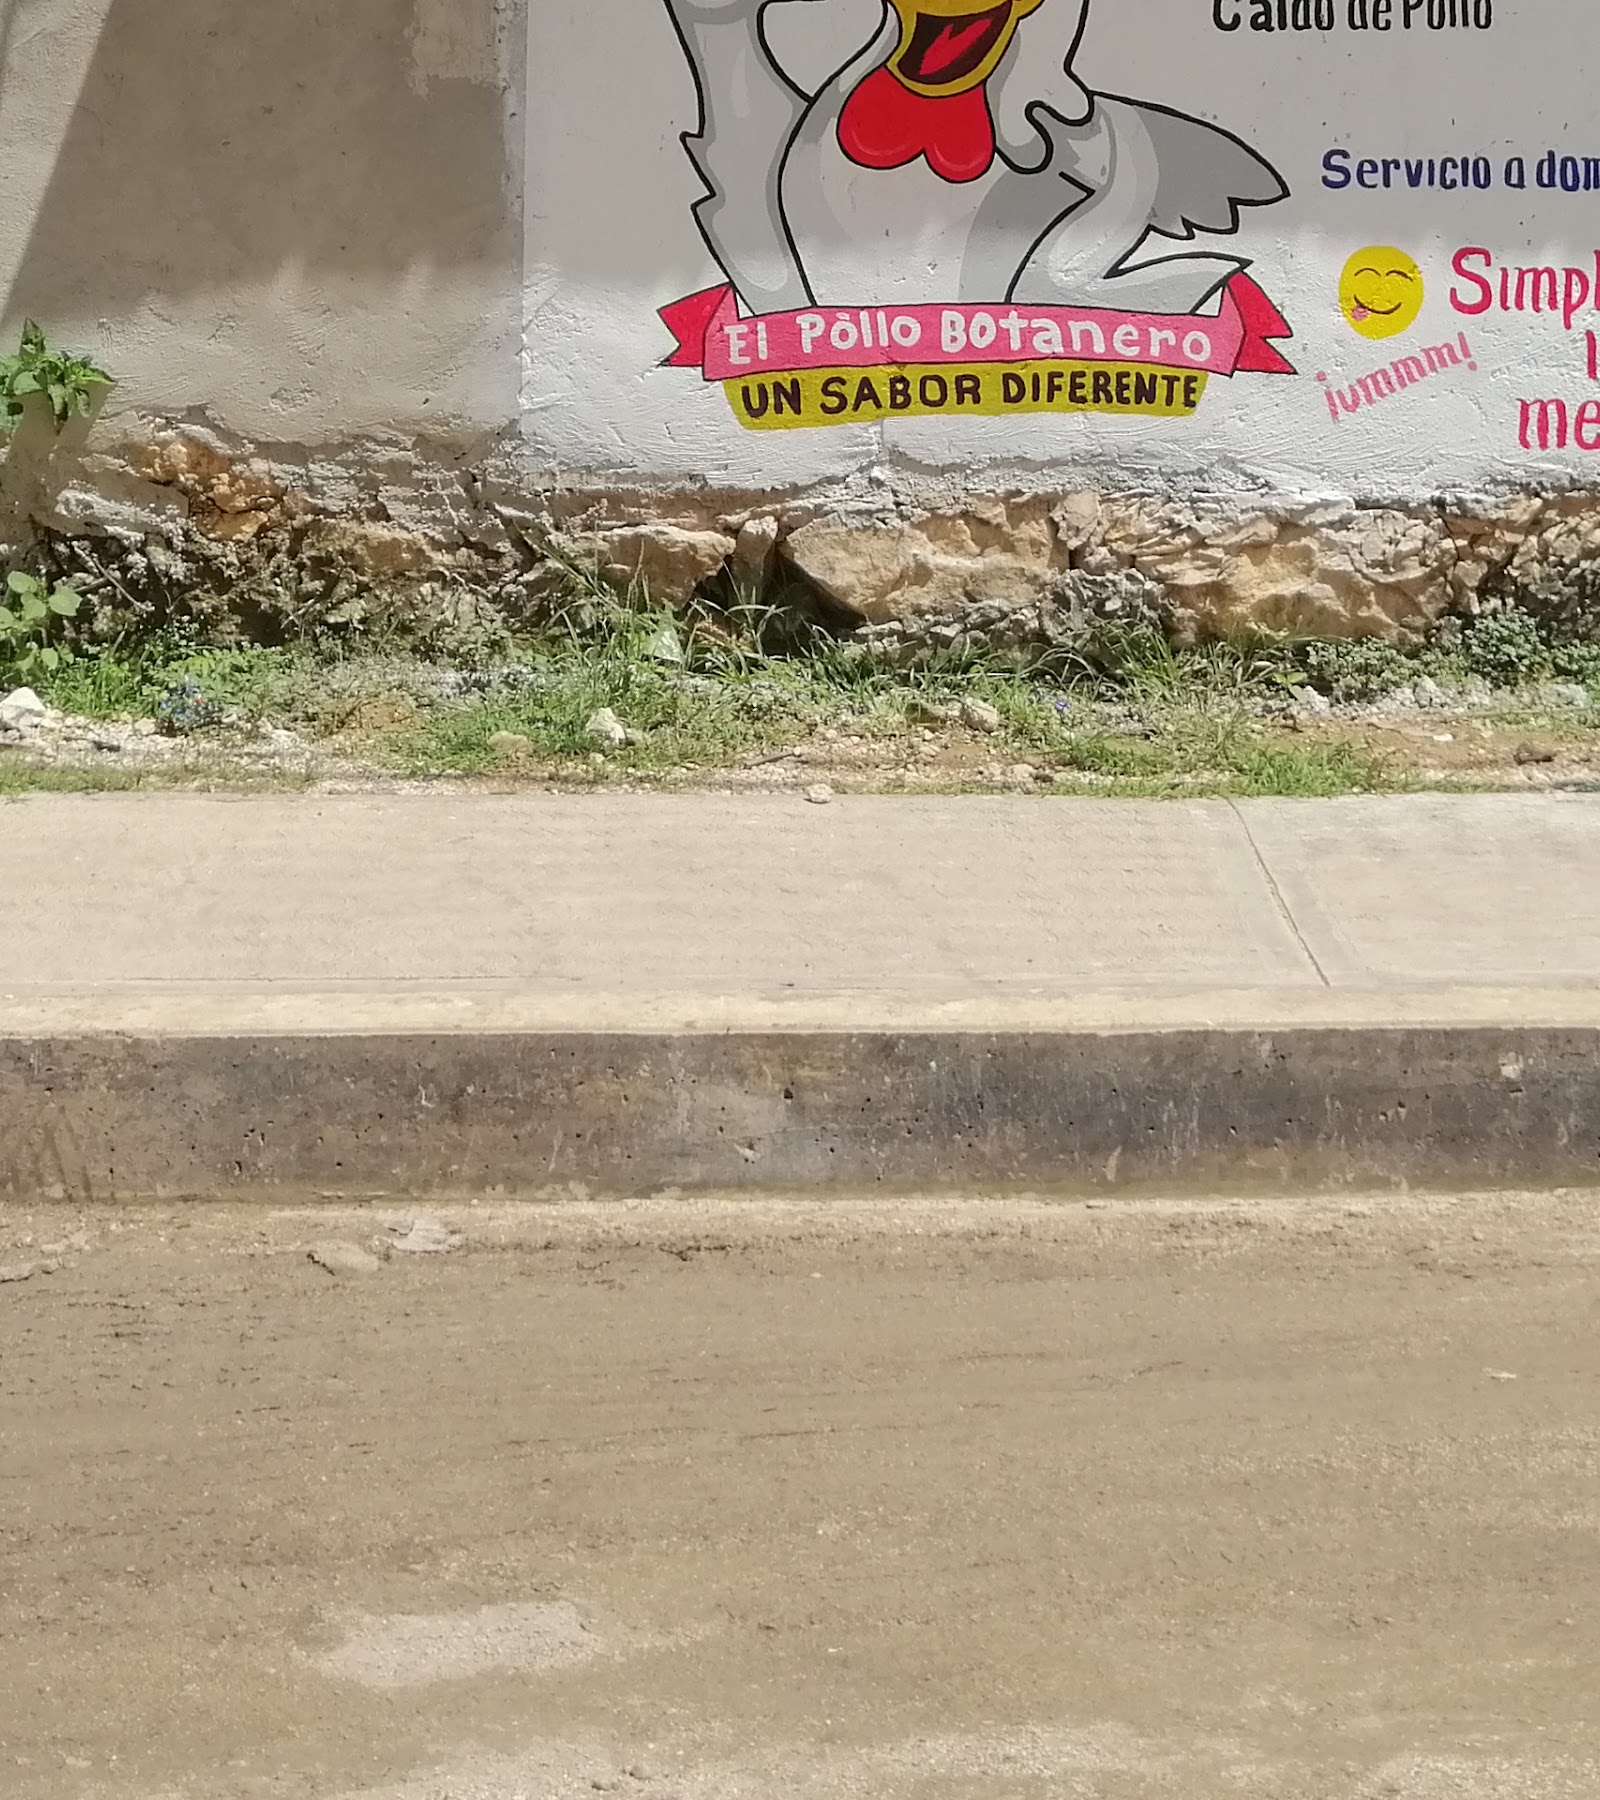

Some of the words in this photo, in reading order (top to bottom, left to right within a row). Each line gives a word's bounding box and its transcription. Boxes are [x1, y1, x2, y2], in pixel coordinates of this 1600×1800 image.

[1321, 148, 1492, 190] Servicio
[1504, 156, 1527, 189] a
[724, 321, 768, 365] El
[940, 310, 1212, 363] Botanero
[741, 376, 802, 419] UN
[820, 373, 983, 415] SABOR
[1002, 373, 1199, 409] DIFERENTE
